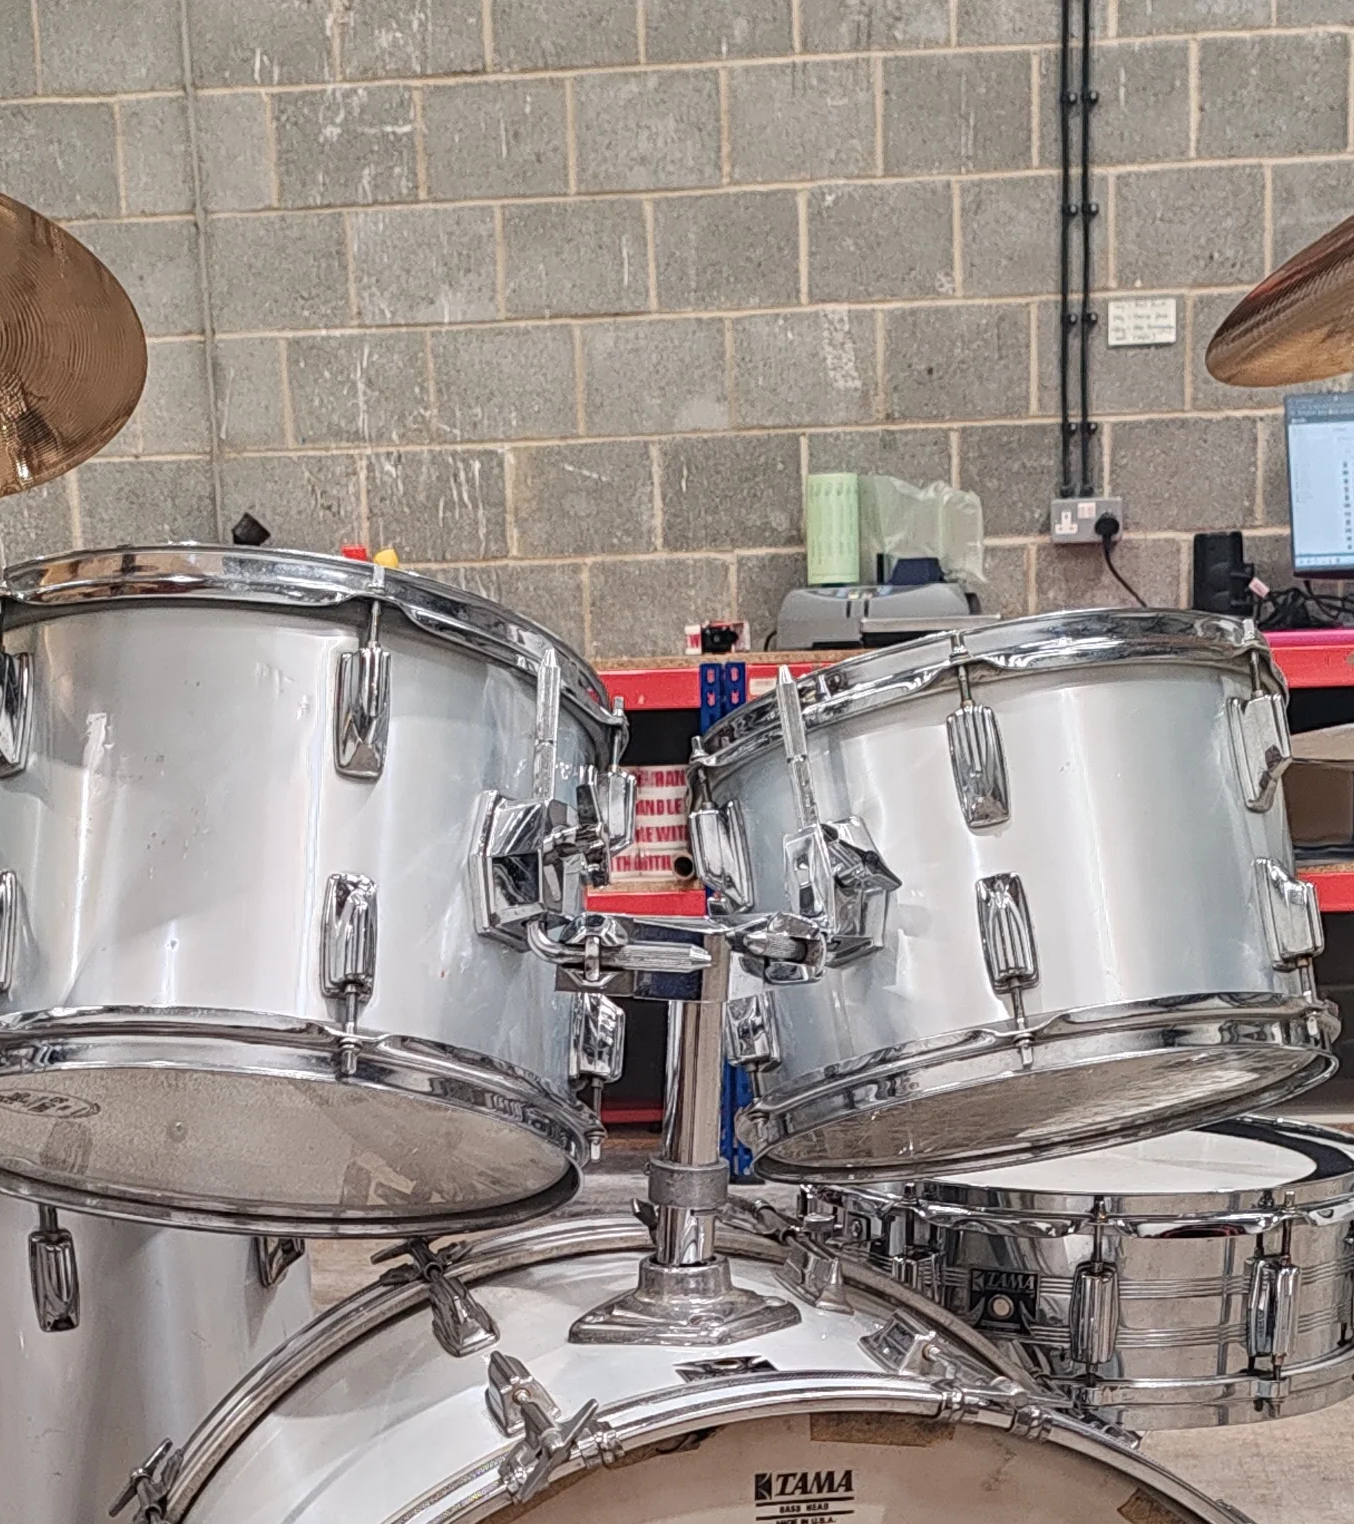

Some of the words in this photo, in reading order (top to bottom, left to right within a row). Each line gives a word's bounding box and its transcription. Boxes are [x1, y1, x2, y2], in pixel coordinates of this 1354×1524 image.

[986, 1272, 1035, 1291] TAMA
[775, 1469, 854, 1497] TAMA
[779, 1504, 801, 1514] BASS
[806, 1502, 829, 1512] HEAD
